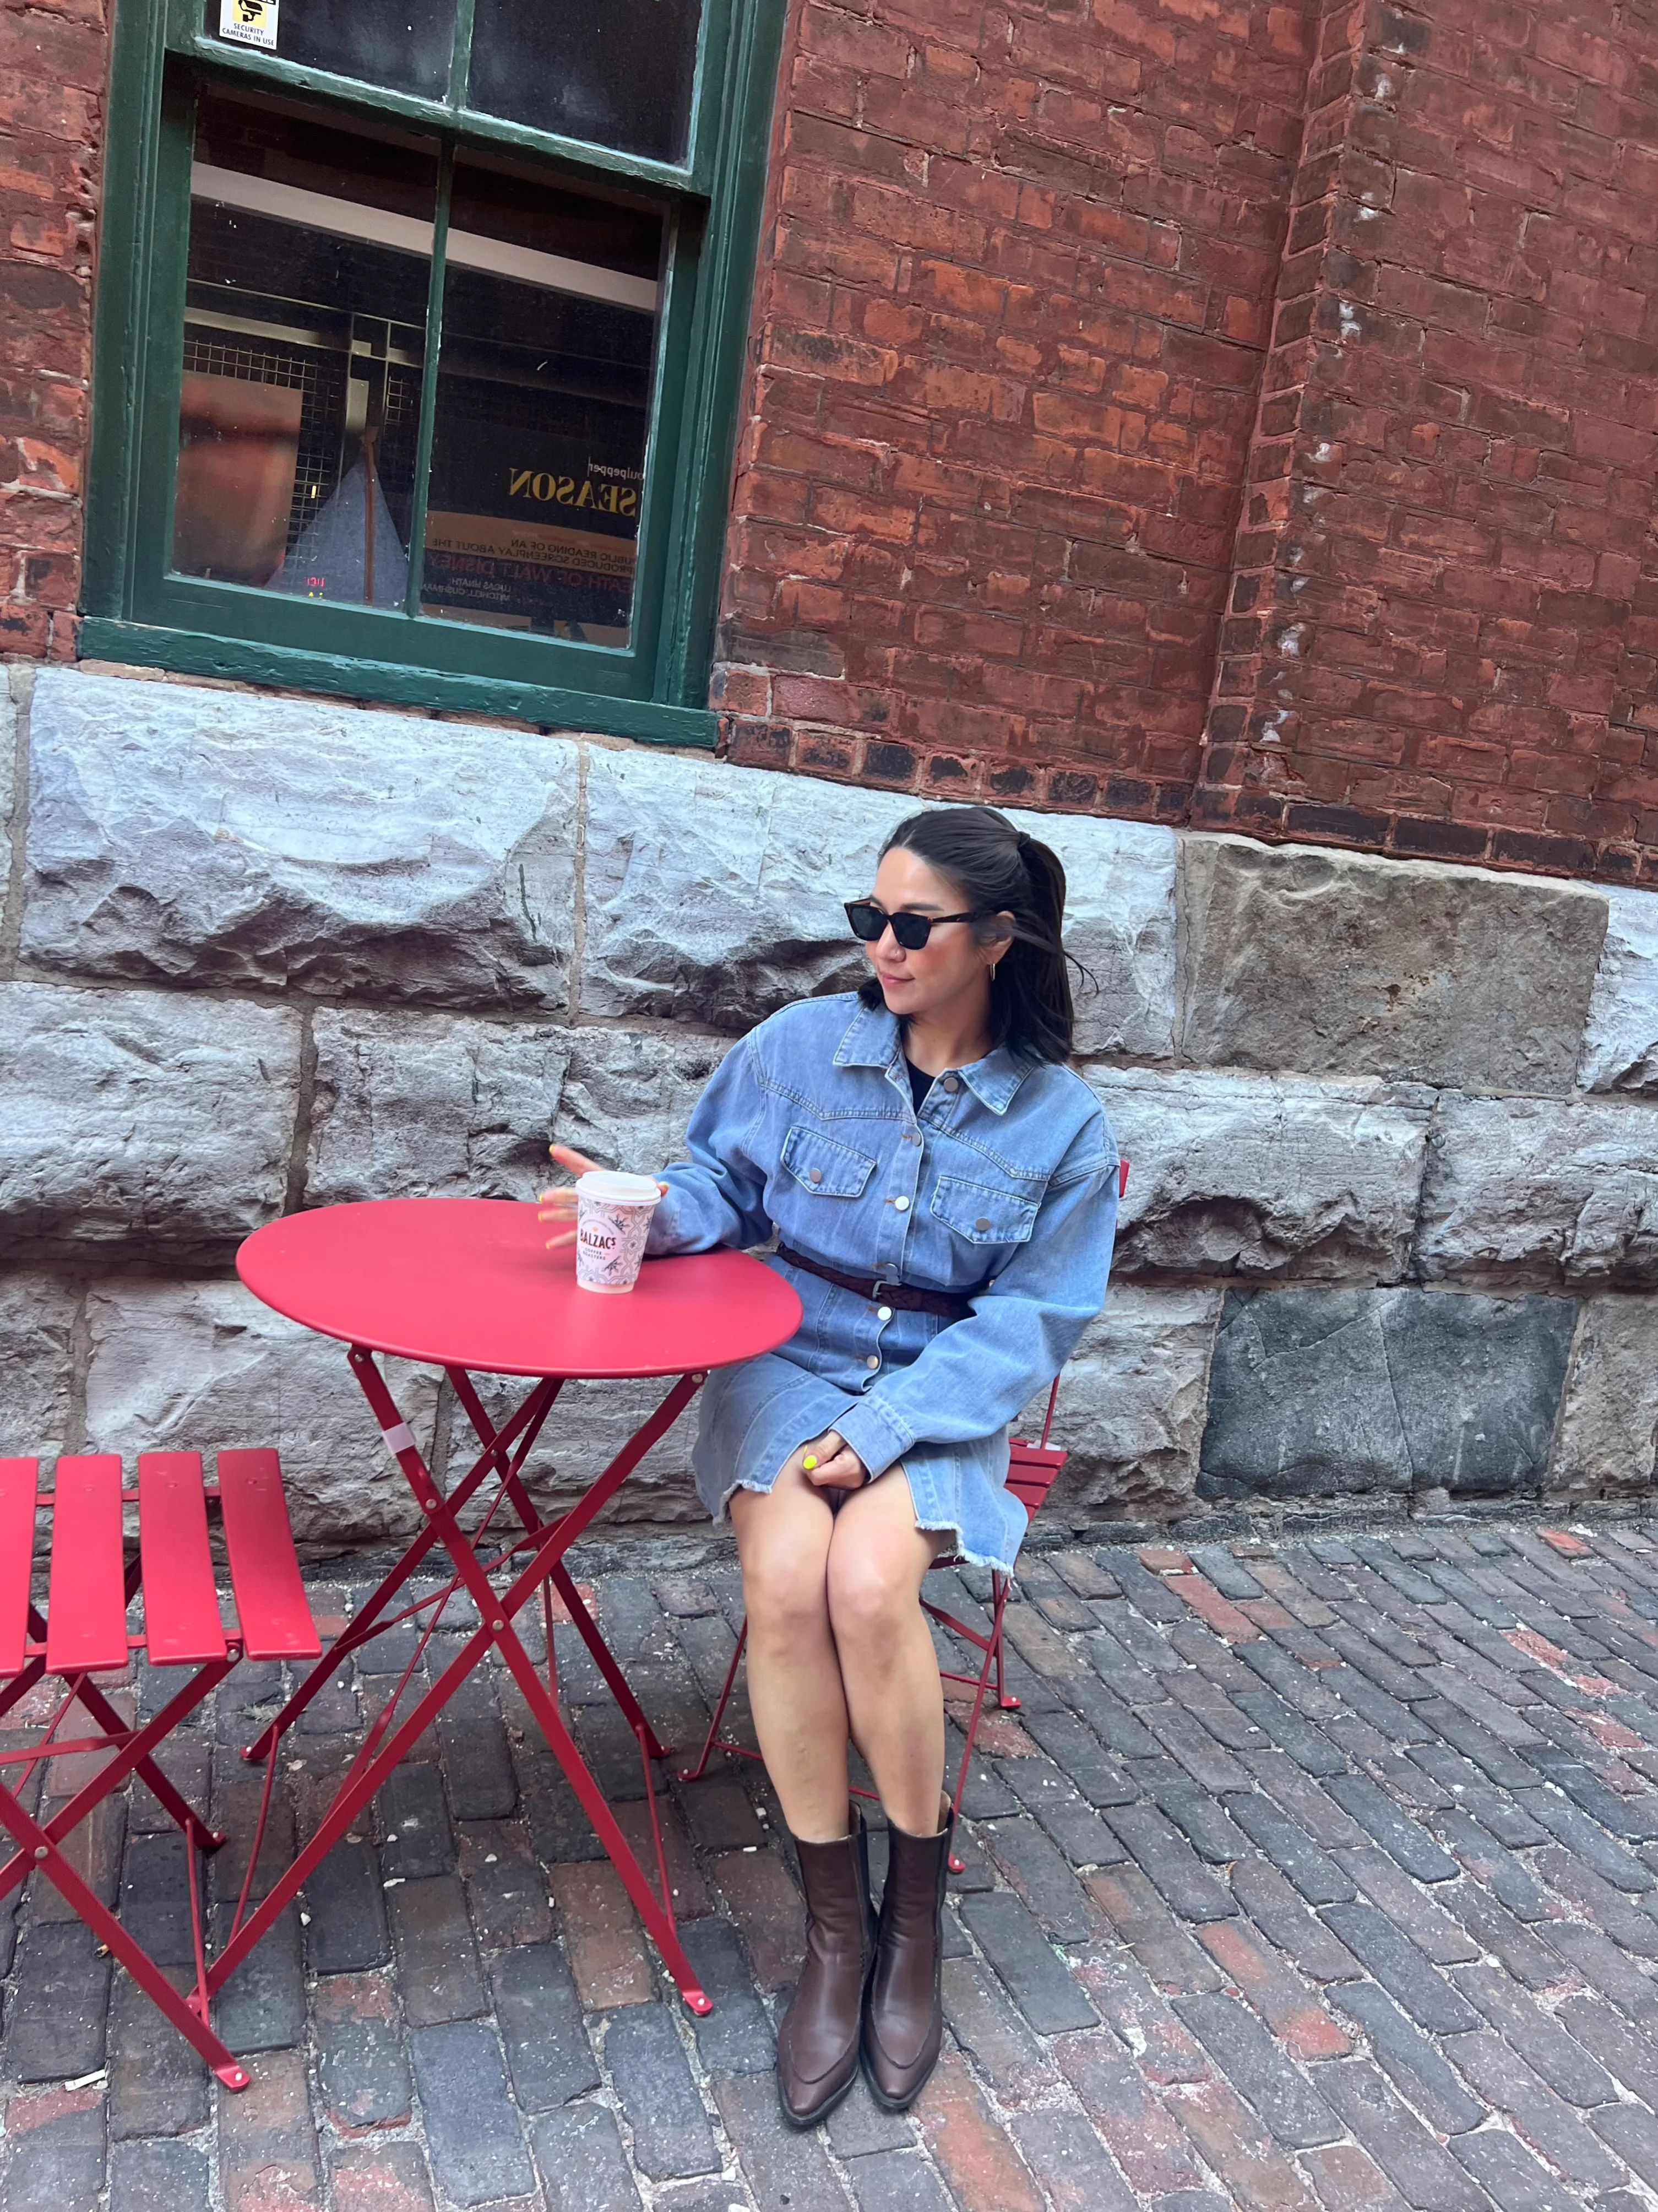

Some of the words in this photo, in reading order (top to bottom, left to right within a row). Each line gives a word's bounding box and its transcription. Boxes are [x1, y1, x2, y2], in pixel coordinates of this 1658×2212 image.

[222, 28, 252, 40] CAMERAS
[263, 37, 274, 46] USE
[233, 23, 264, 36] SECURITY
